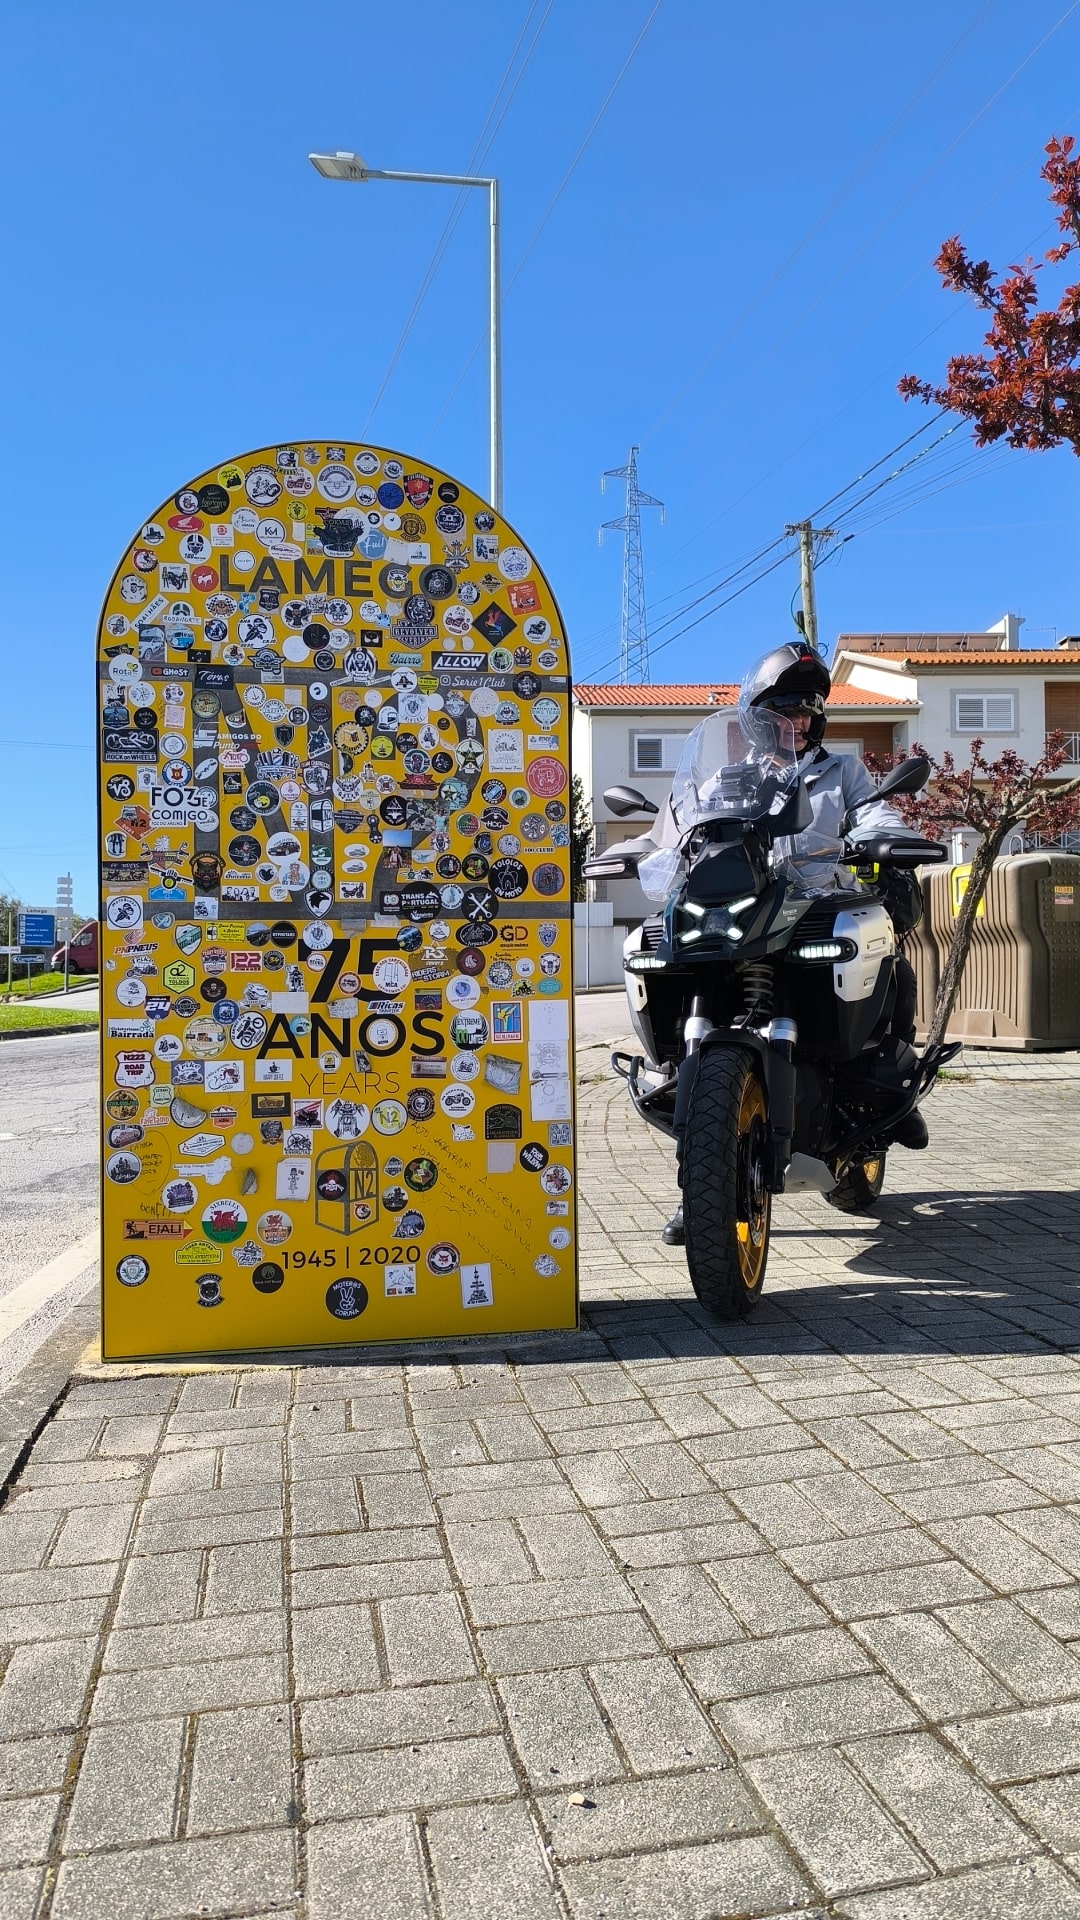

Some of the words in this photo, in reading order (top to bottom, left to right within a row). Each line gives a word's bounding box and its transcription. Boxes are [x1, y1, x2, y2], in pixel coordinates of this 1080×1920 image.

[219, 554, 458, 600] LAMEGO
[395, 626, 434, 636] REVOLVER
[436, 656, 483, 667] ALLOW
[151, 810, 208, 826] COMIGO
[492, 859, 523, 871] TOLOLOS
[494, 887, 504, 897] EN
[504, 886, 523, 898] MOTO
[297, 938, 409, 1003] 75
[145, 1001, 171, 1011] 24
[377, 1001, 404, 1009] Ricas
[111, 1030, 154, 1038] Bairrada
[256, 1011, 445, 1059] ANOS
[300, 1071, 400, 1095] YEARS
[354, 1169, 375, 1199] N2
[148, 1224, 182, 1234] EJALI
[281, 1249, 336, 1270] 1945
[359, 1245, 421, 1266] 2020
